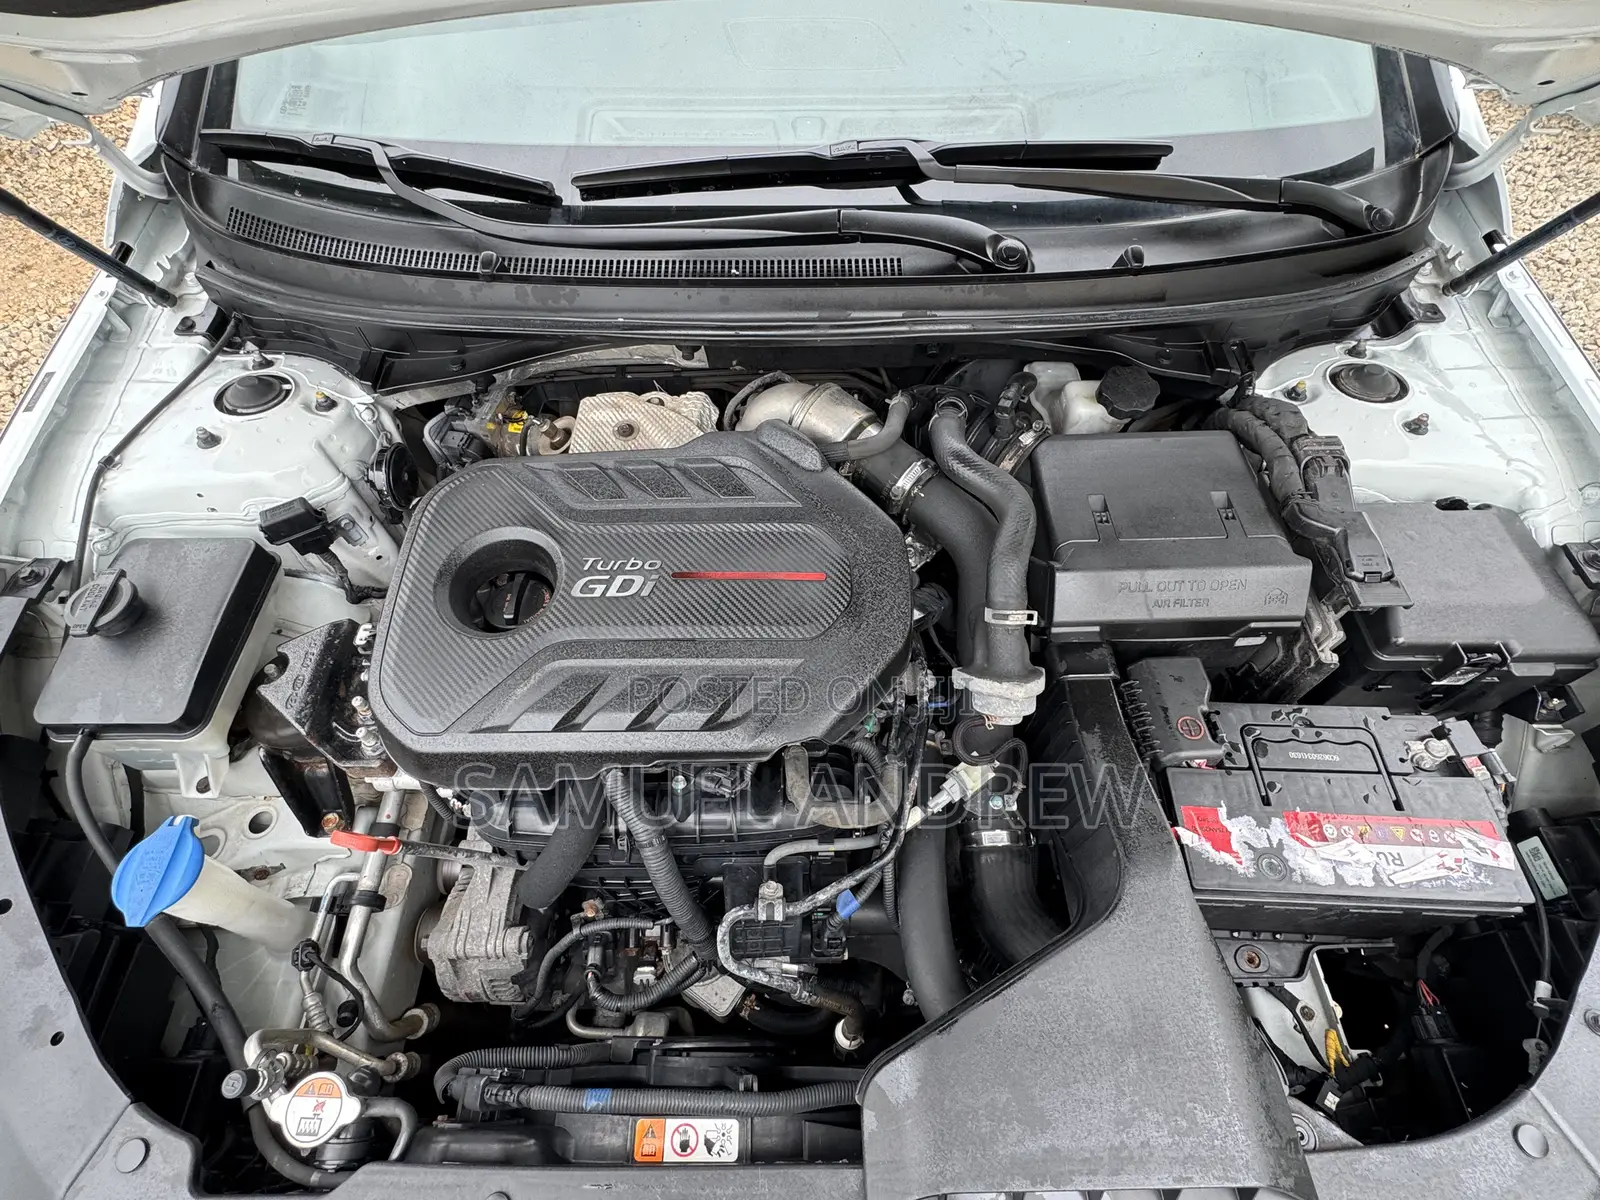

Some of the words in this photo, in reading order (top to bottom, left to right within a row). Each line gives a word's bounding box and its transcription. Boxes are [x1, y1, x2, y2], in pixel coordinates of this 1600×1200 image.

[582, 557, 663, 571] Turbo
[570, 574, 661, 598] GDi
[1118, 581, 1152, 593] PULL
[1156, 580, 1184, 592] OUT
[1188, 580, 1206, 591] TO
[1209, 578, 1248, 592] OPEN
[79, 583, 100, 611] COOLANT
[1151, 599, 1171, 609] AIR
[1173, 598, 1210, 608] FILTER
